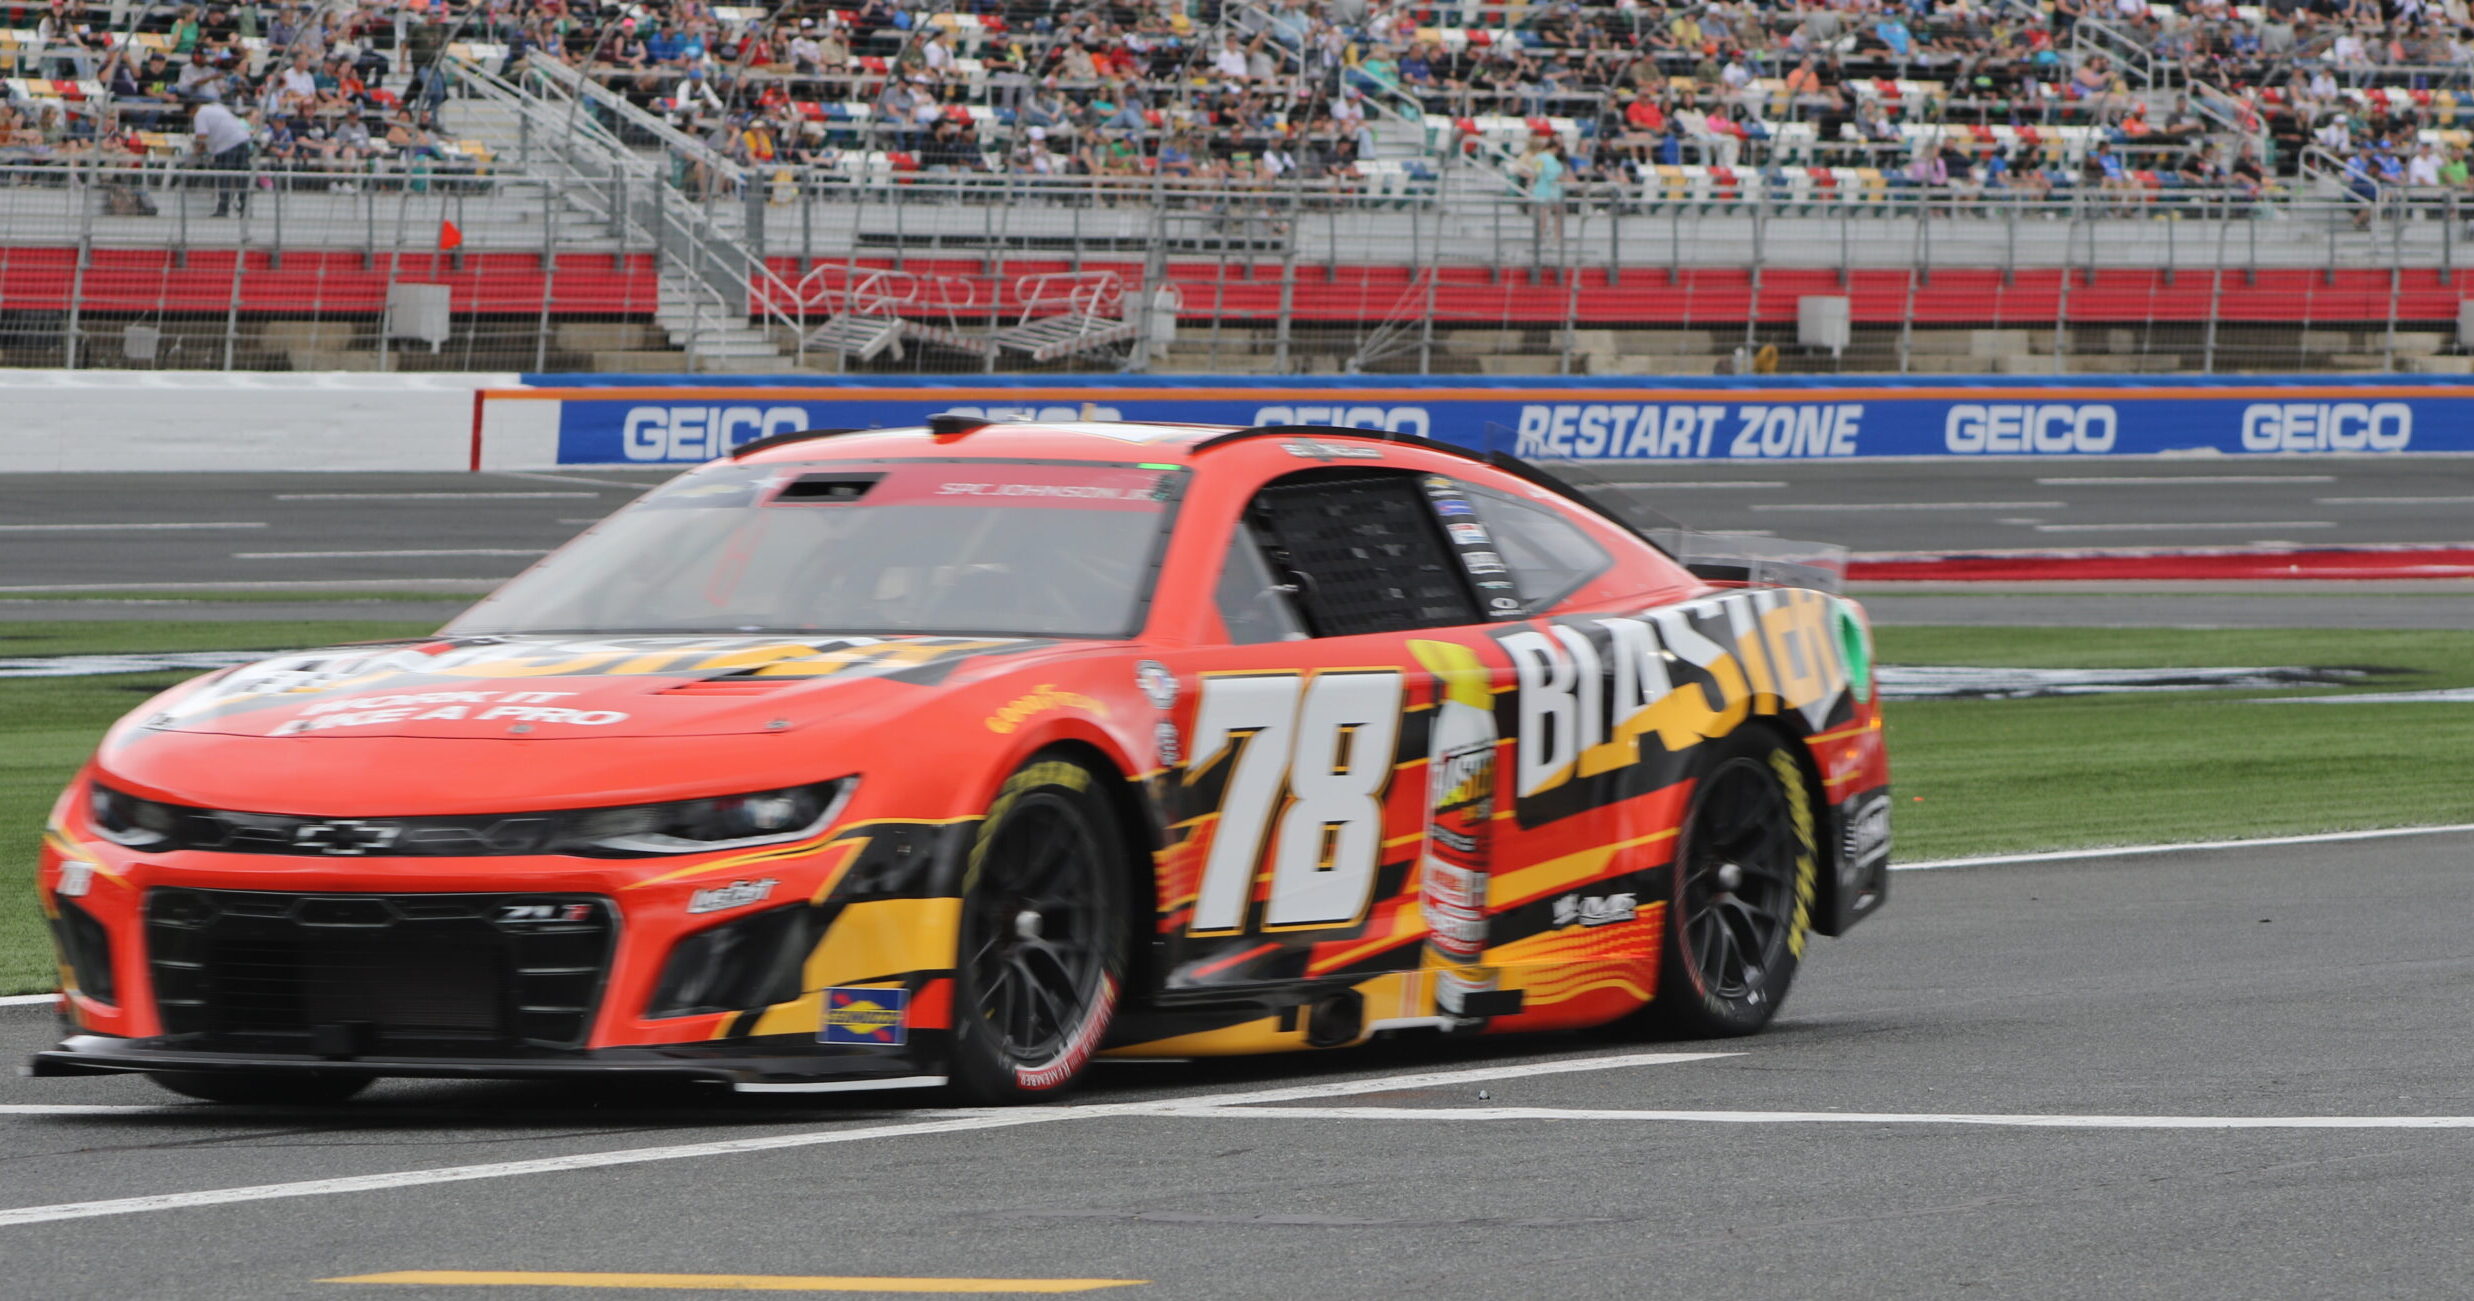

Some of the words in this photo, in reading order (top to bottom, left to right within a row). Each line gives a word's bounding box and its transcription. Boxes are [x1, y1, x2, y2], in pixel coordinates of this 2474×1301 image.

[1515, 404, 1726, 457] RESTART
[1729, 403, 1865, 457] ZONE
[1945, 404, 2117, 453] GEICO
[2242, 402, 2413, 452] GEICO
[298, 691, 505, 716] WORK
[495, 691, 579, 704] IT
[409, 706, 470, 720] A
[473, 706, 630, 726] PRO
[1187, 669, 1403, 934] 78
